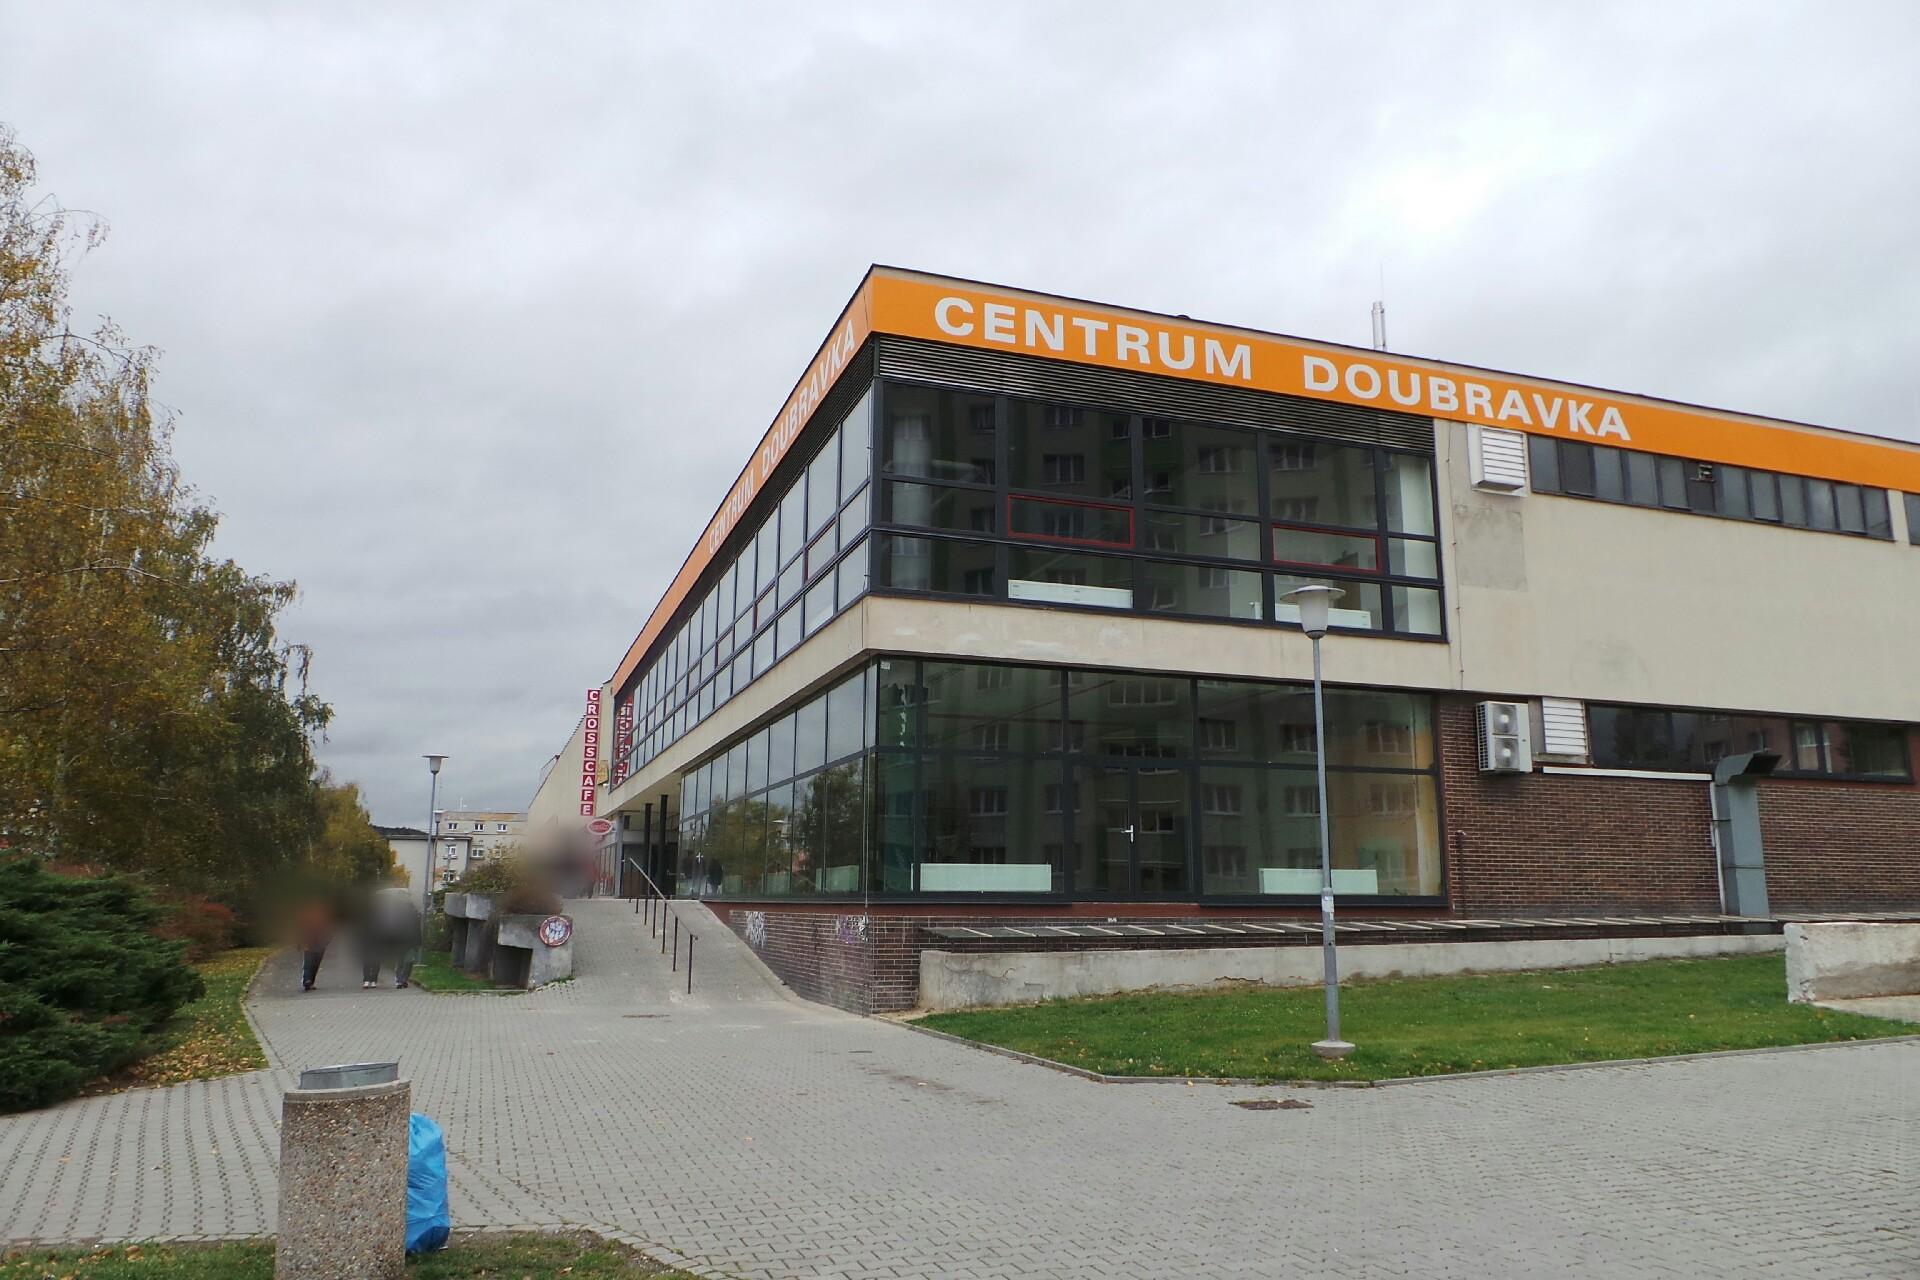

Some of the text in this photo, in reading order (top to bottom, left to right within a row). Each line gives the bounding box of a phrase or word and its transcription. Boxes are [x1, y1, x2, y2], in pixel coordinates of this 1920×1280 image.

[708, 319, 855, 554] CENTRUM DOUBRAVKA
[934, 296, 1632, 441] CENTRUM DOUBRAVKA
[582, 690, 599, 815] CROSSCAFE
